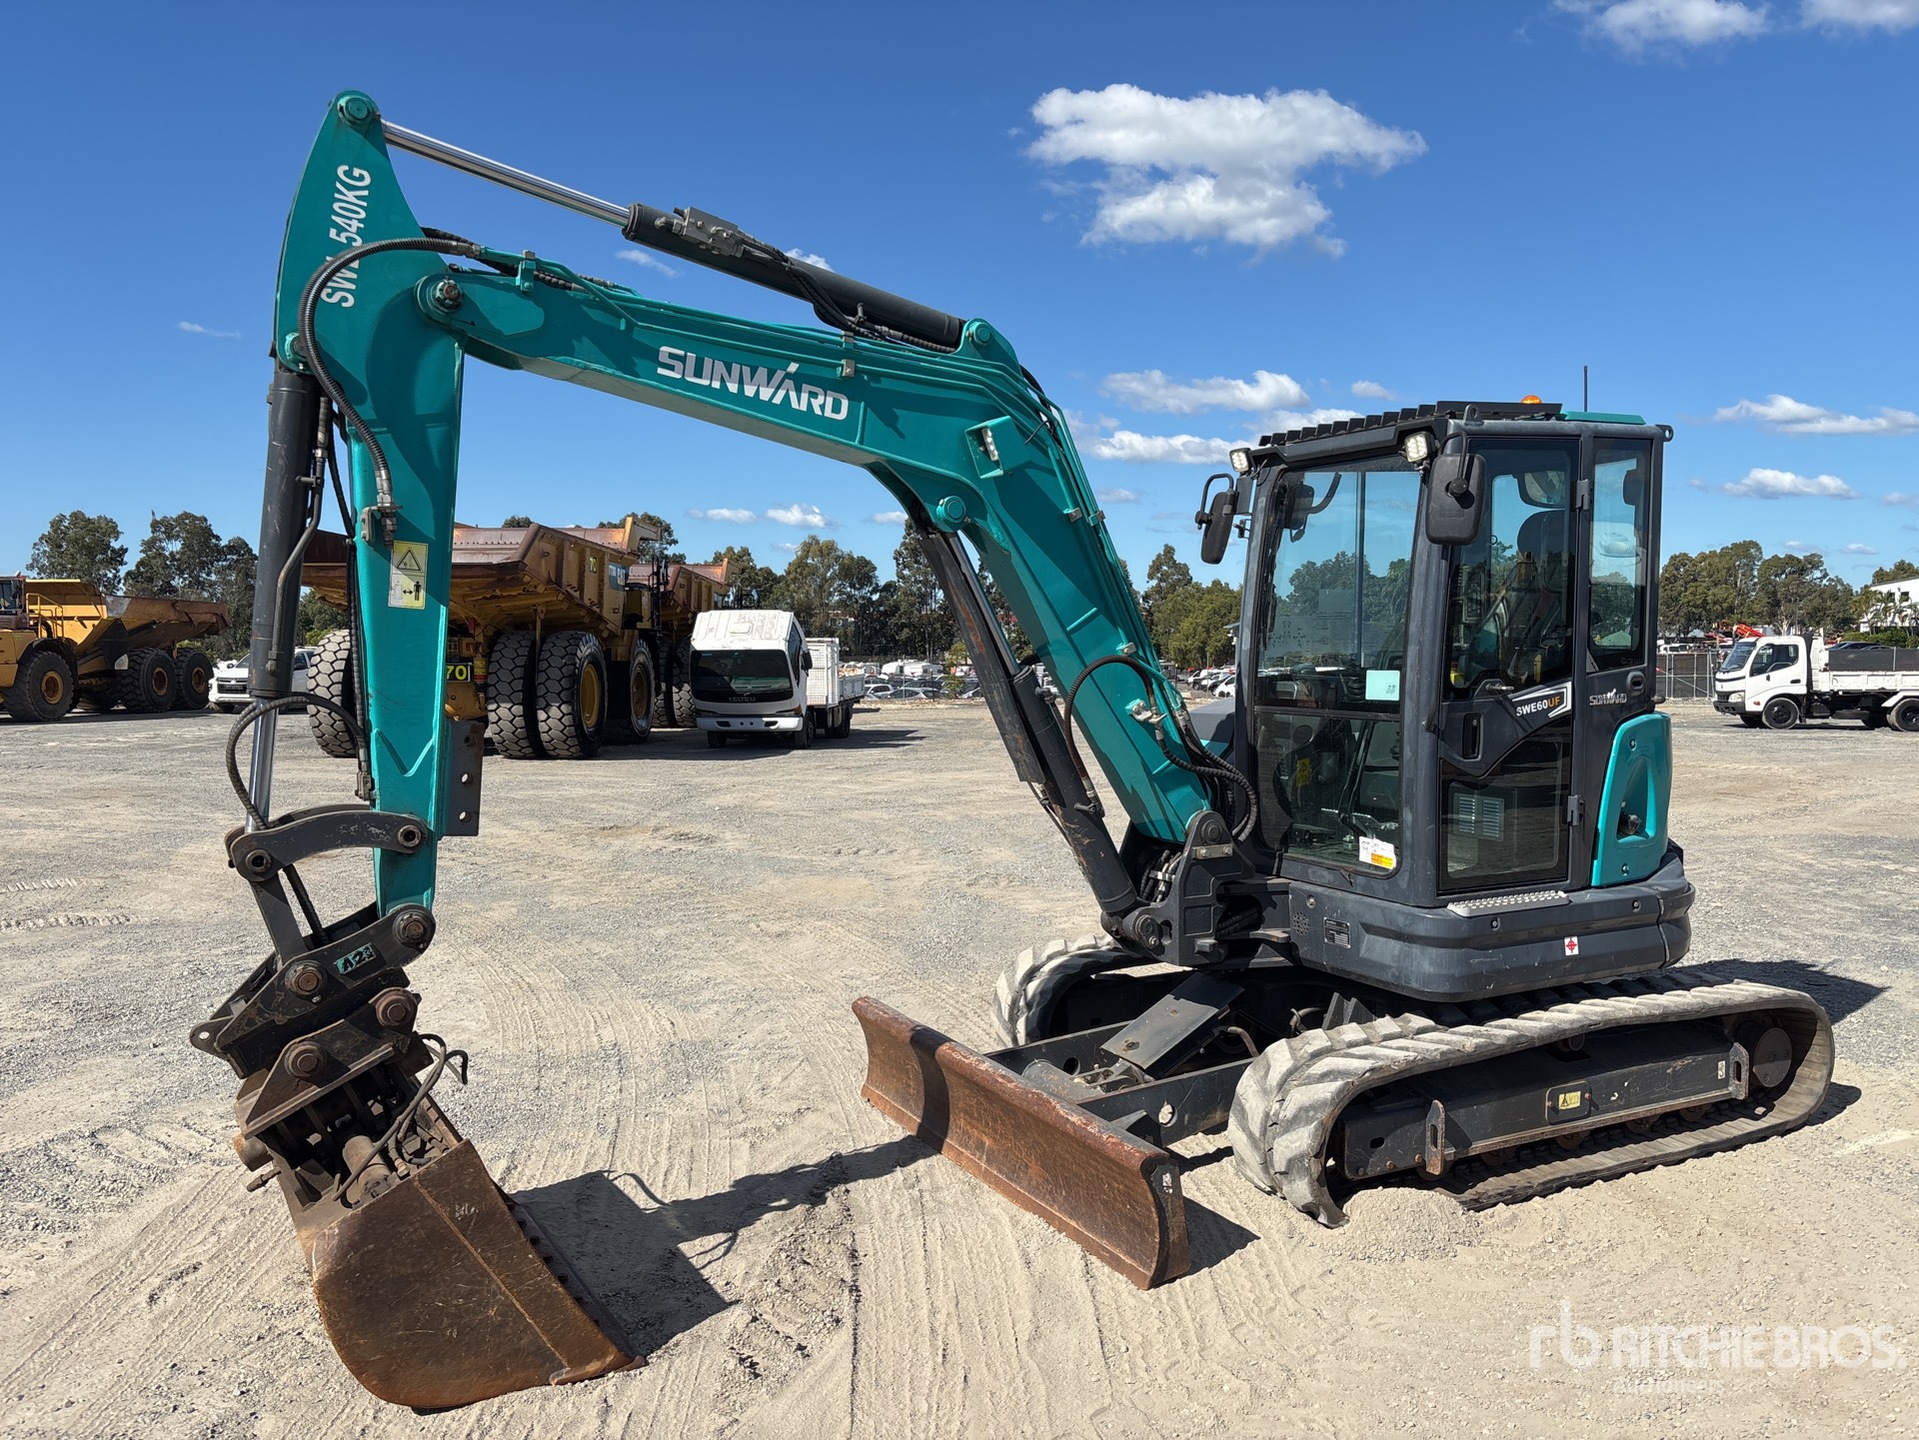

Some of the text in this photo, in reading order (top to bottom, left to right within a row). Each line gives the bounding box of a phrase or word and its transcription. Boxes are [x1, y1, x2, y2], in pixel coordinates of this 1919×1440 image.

[327, 164, 372, 247] 540KG
[656, 345, 849, 421] SUNWARD
[1515, 695, 1561, 717] SWE60UF
